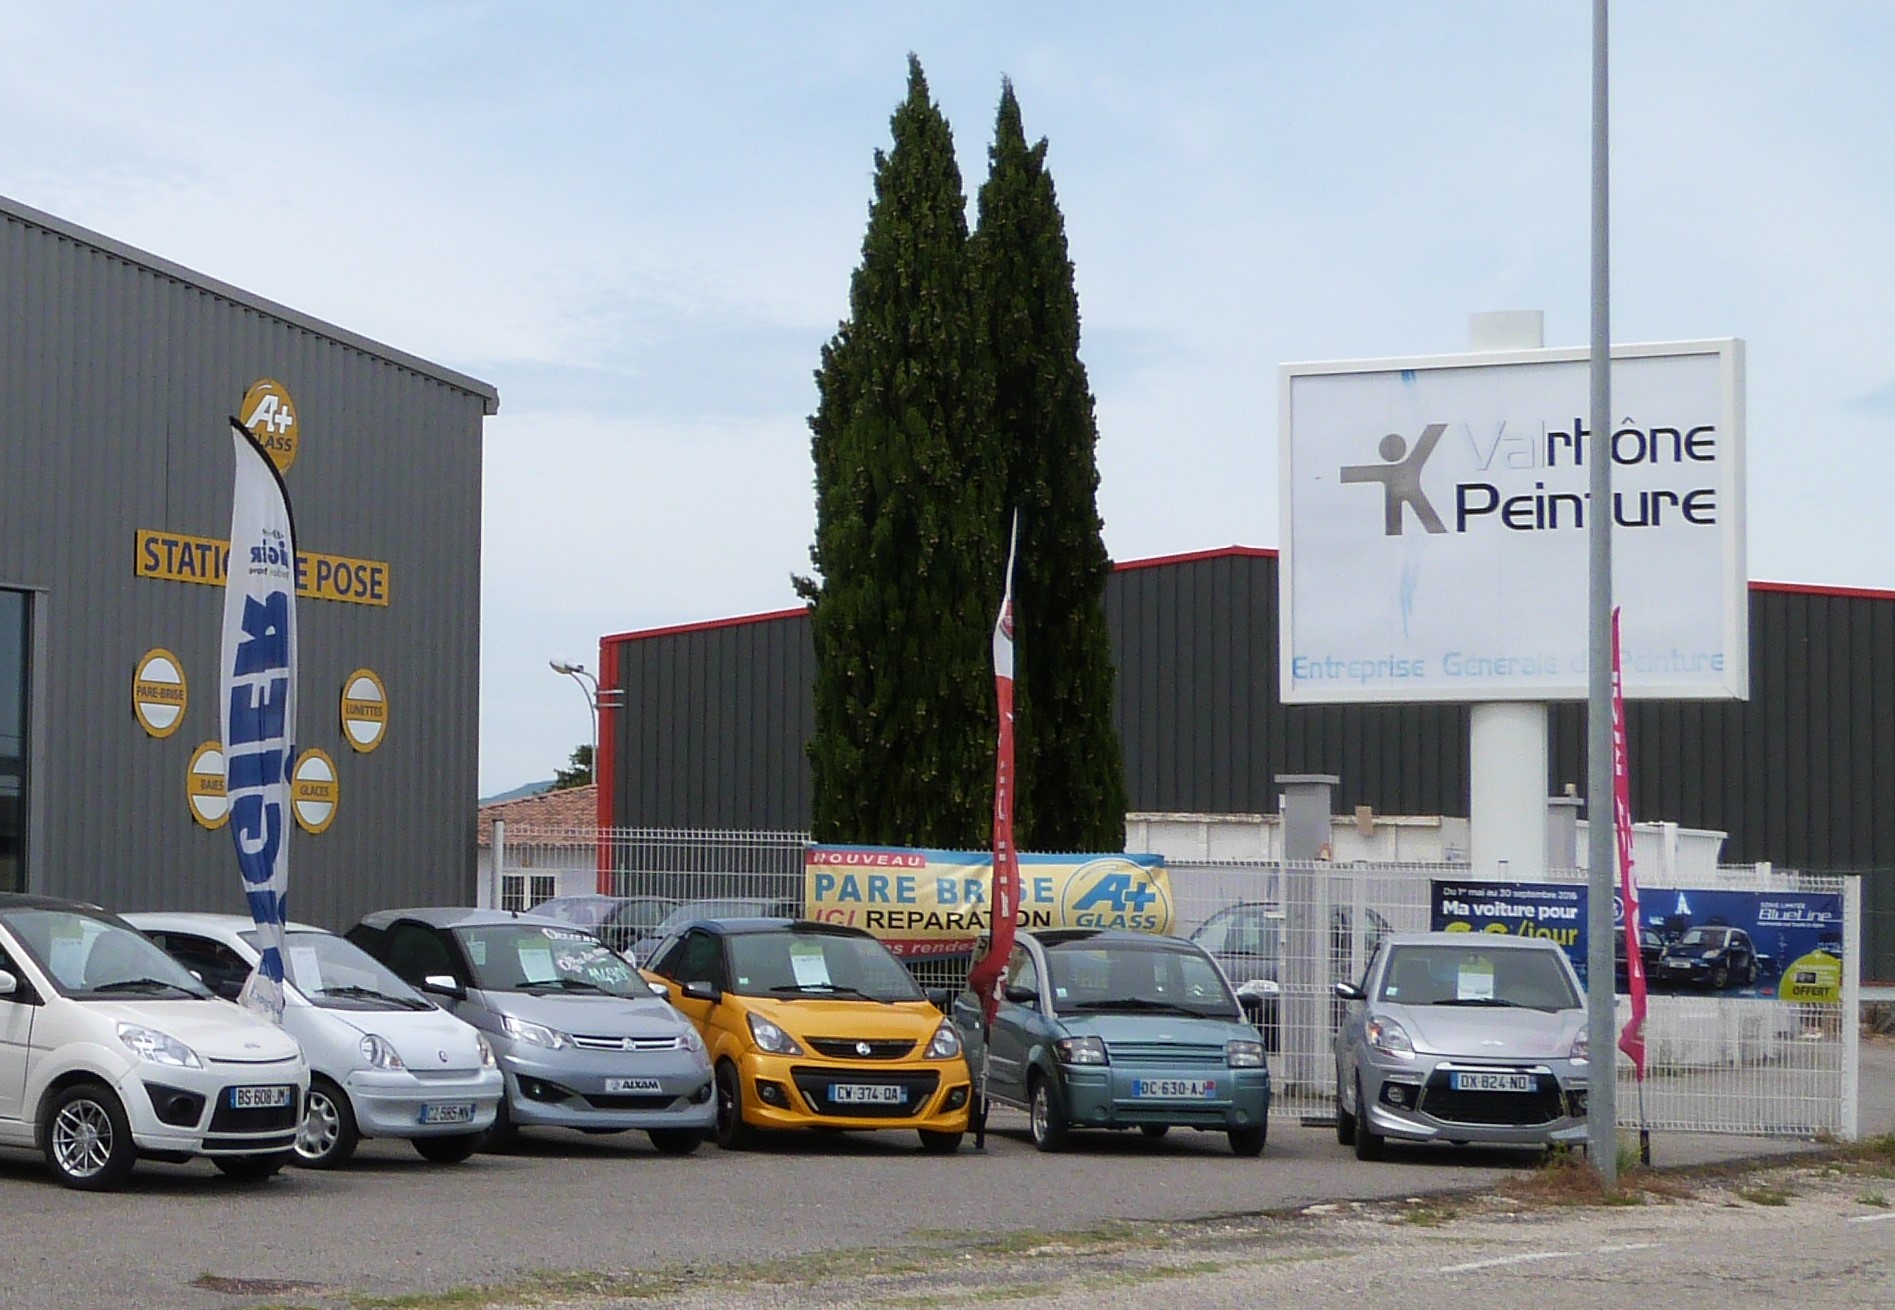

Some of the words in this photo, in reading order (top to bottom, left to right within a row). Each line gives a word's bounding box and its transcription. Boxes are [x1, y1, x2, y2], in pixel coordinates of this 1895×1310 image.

[245, 394, 292, 434] A+
[252, 432, 292, 452] LASS
[1456, 482, 1716, 533] Peinure
[144, 537, 231, 581] STATI
[317, 559, 383, 599] POSE
[1292, 654, 1425, 686] Entreprise
[136, 687, 184, 700] PARE-BRISE
[345, 703, 384, 717] LUNETTES
[299, 785, 330, 797] GLACES
[813, 852, 920, 866] NOUVEAU
[815, 873, 917, 904] PARE
[936, 877, 1054, 904] BRSE
[1071, 872, 1156, 911] A+
[1468, 888, 1485, 897] mai
[1486, 889, 1497, 897] au
[1513, 890, 1556, 899] septembre
[815, 909, 856, 928] ICI
[866, 910, 1051, 931] REPARATON
[1443, 900, 1470, 916] Ma
[1473, 901, 1535, 918] voiture
[1538, 905, 1578, 920] pour
[1074, 911, 1158, 931] GLASS
[1793, 986, 1830, 996] OFFERT
[622, 1080, 659, 1089] AIXAM
